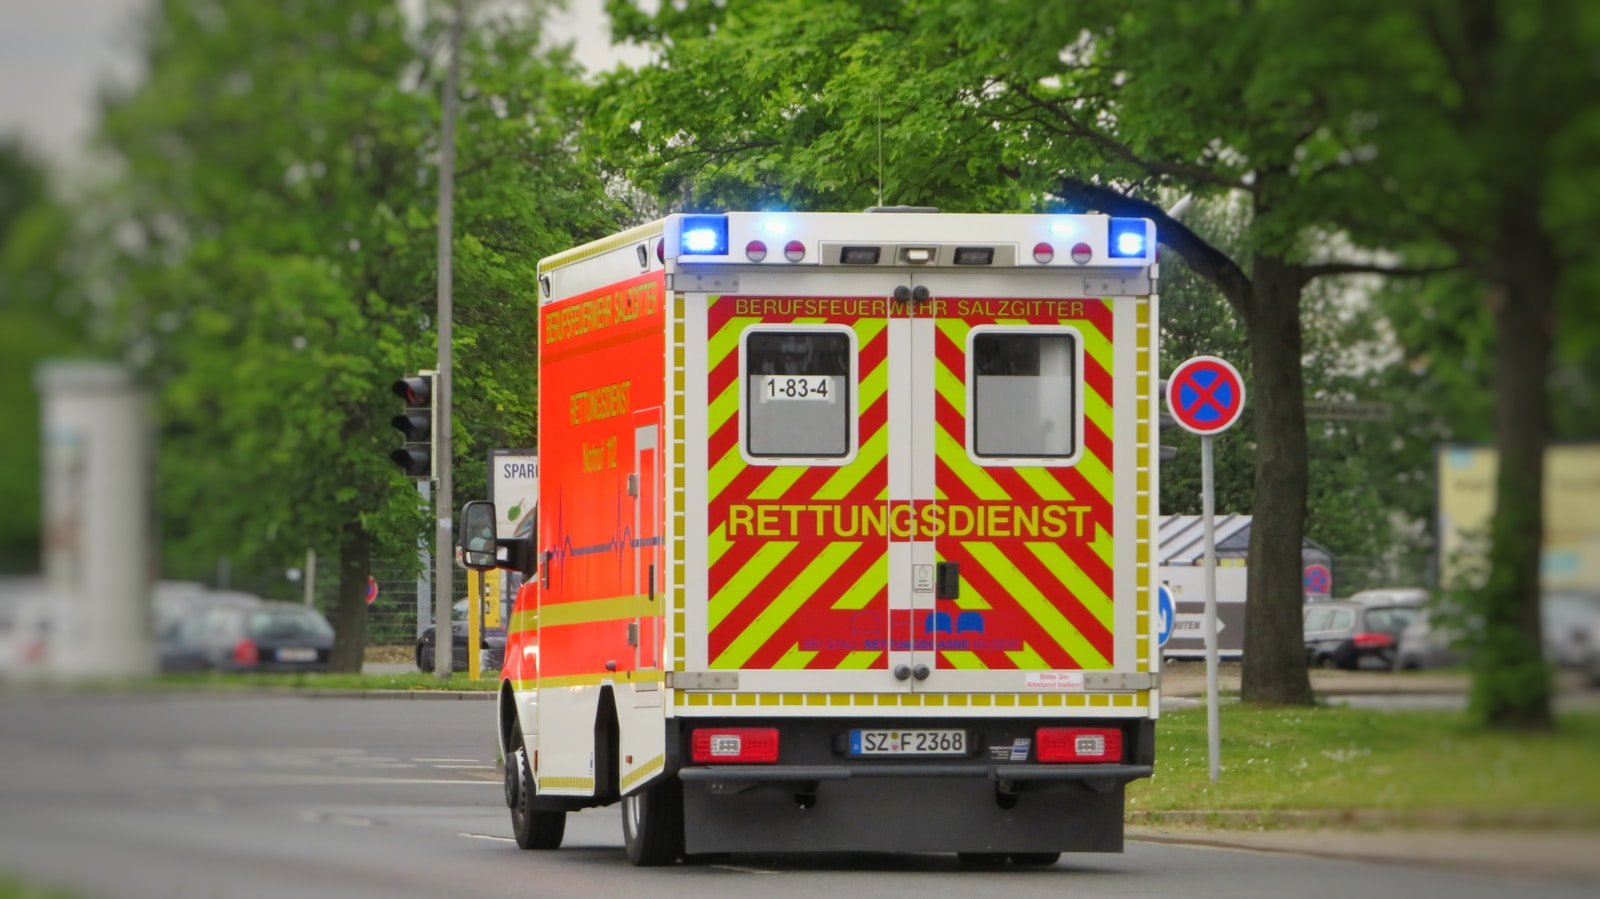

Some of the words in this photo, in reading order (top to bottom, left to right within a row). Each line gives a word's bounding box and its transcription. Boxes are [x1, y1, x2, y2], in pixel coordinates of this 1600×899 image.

[735, 299, 947, 316] BERUFSFEUERWEHR
[958, 300, 1084, 317] SALZGITTER
[766, 378, 829, 398] 1-83-4
[729, 504, 1092, 537] RETTUNGSDIENST
[864, 733, 888, 751] SZ
[901, 733, 912, 751] F
[916, 733, 963, 750] 2368
